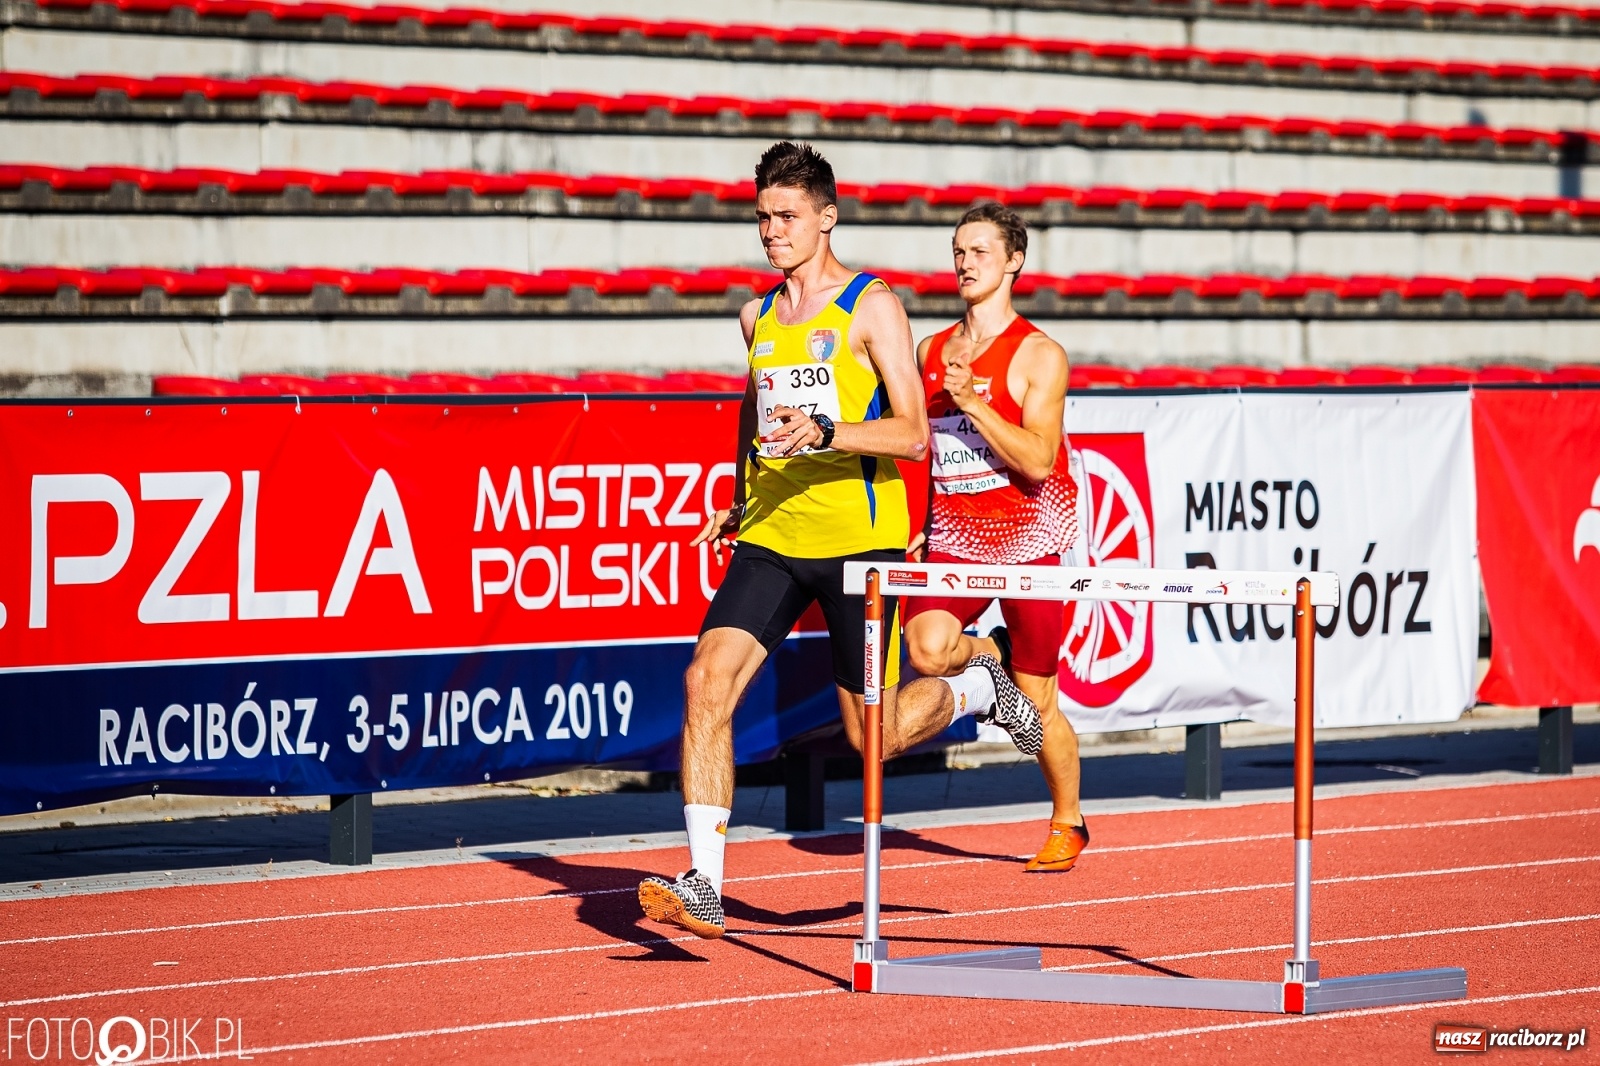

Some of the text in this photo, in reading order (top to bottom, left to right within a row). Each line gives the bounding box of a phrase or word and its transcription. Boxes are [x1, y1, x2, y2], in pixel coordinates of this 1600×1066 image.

[790, 367, 830, 388] 330
[976, 478, 997, 490] 2019
[1185, 479, 1320, 532] MIASTO
[28, 468, 433, 629] PZLA
[471, 541, 679, 613] POLSKI
[968, 577, 1005, 588] ORLEN
[1069, 578, 1092, 592] 4F
[1162, 585, 1194, 593] 4MOVE
[865, 642, 875, 689] polanik
[99, 680, 634, 767] RACIBÓRZ, 3-5 LIPCA 2019
